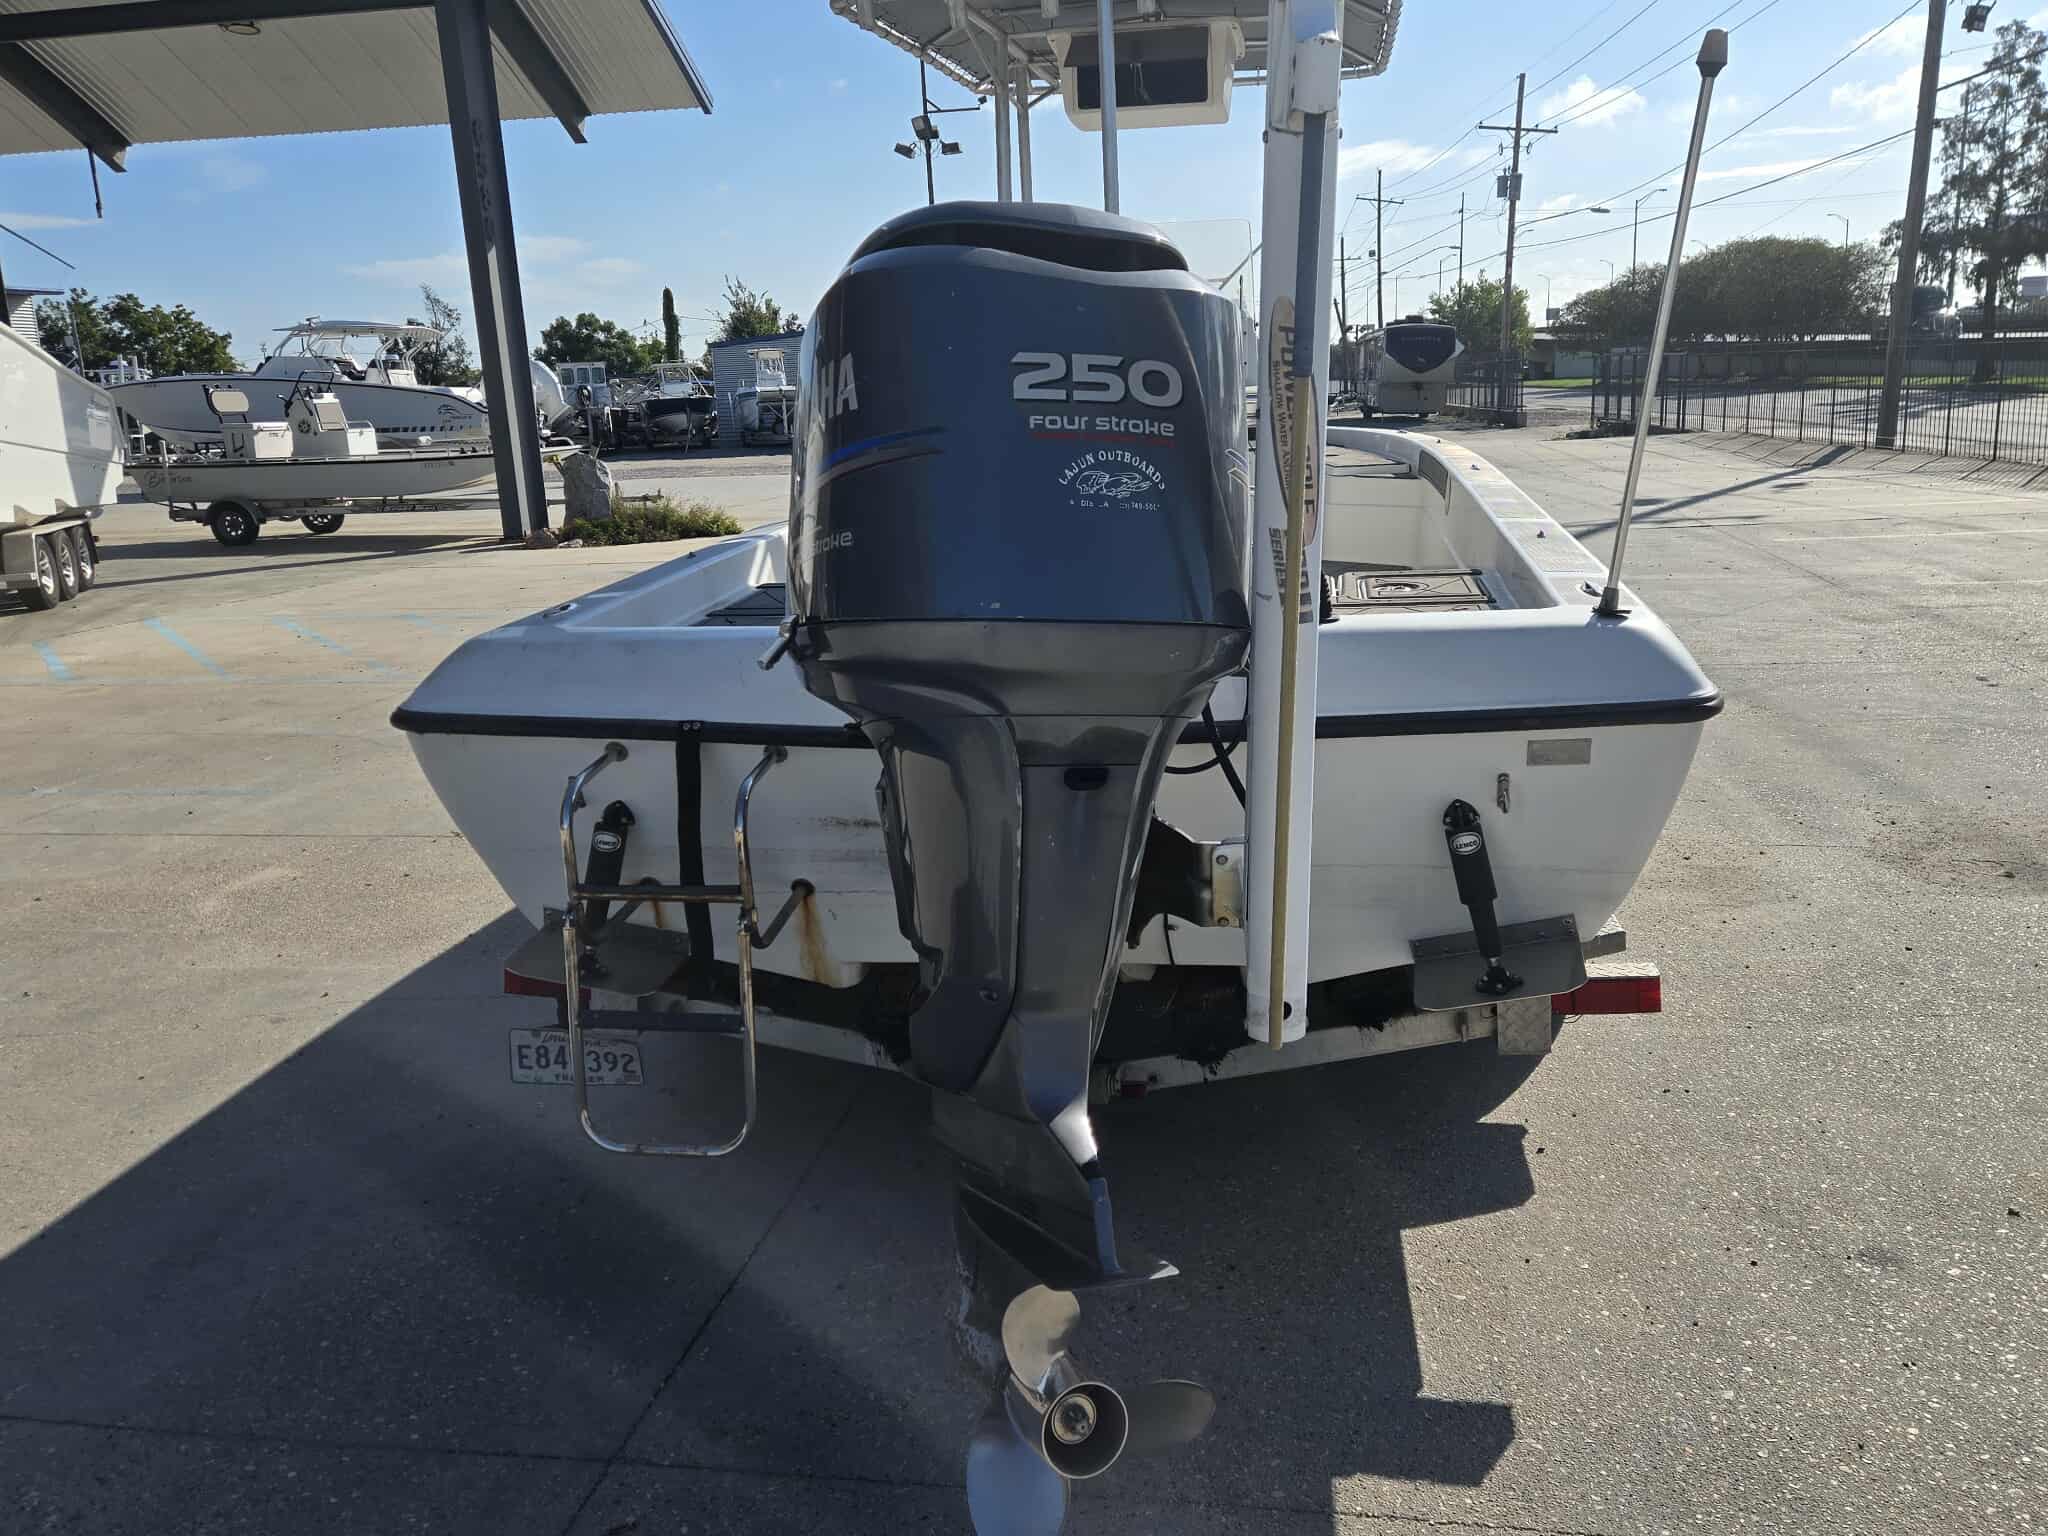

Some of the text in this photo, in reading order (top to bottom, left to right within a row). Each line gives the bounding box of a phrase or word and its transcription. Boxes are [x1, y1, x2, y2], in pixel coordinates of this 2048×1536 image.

[1010, 352, 1183, 408] 250
[1277, 412, 1288, 447] WATER
[517, 1044, 637, 1074] E84392
